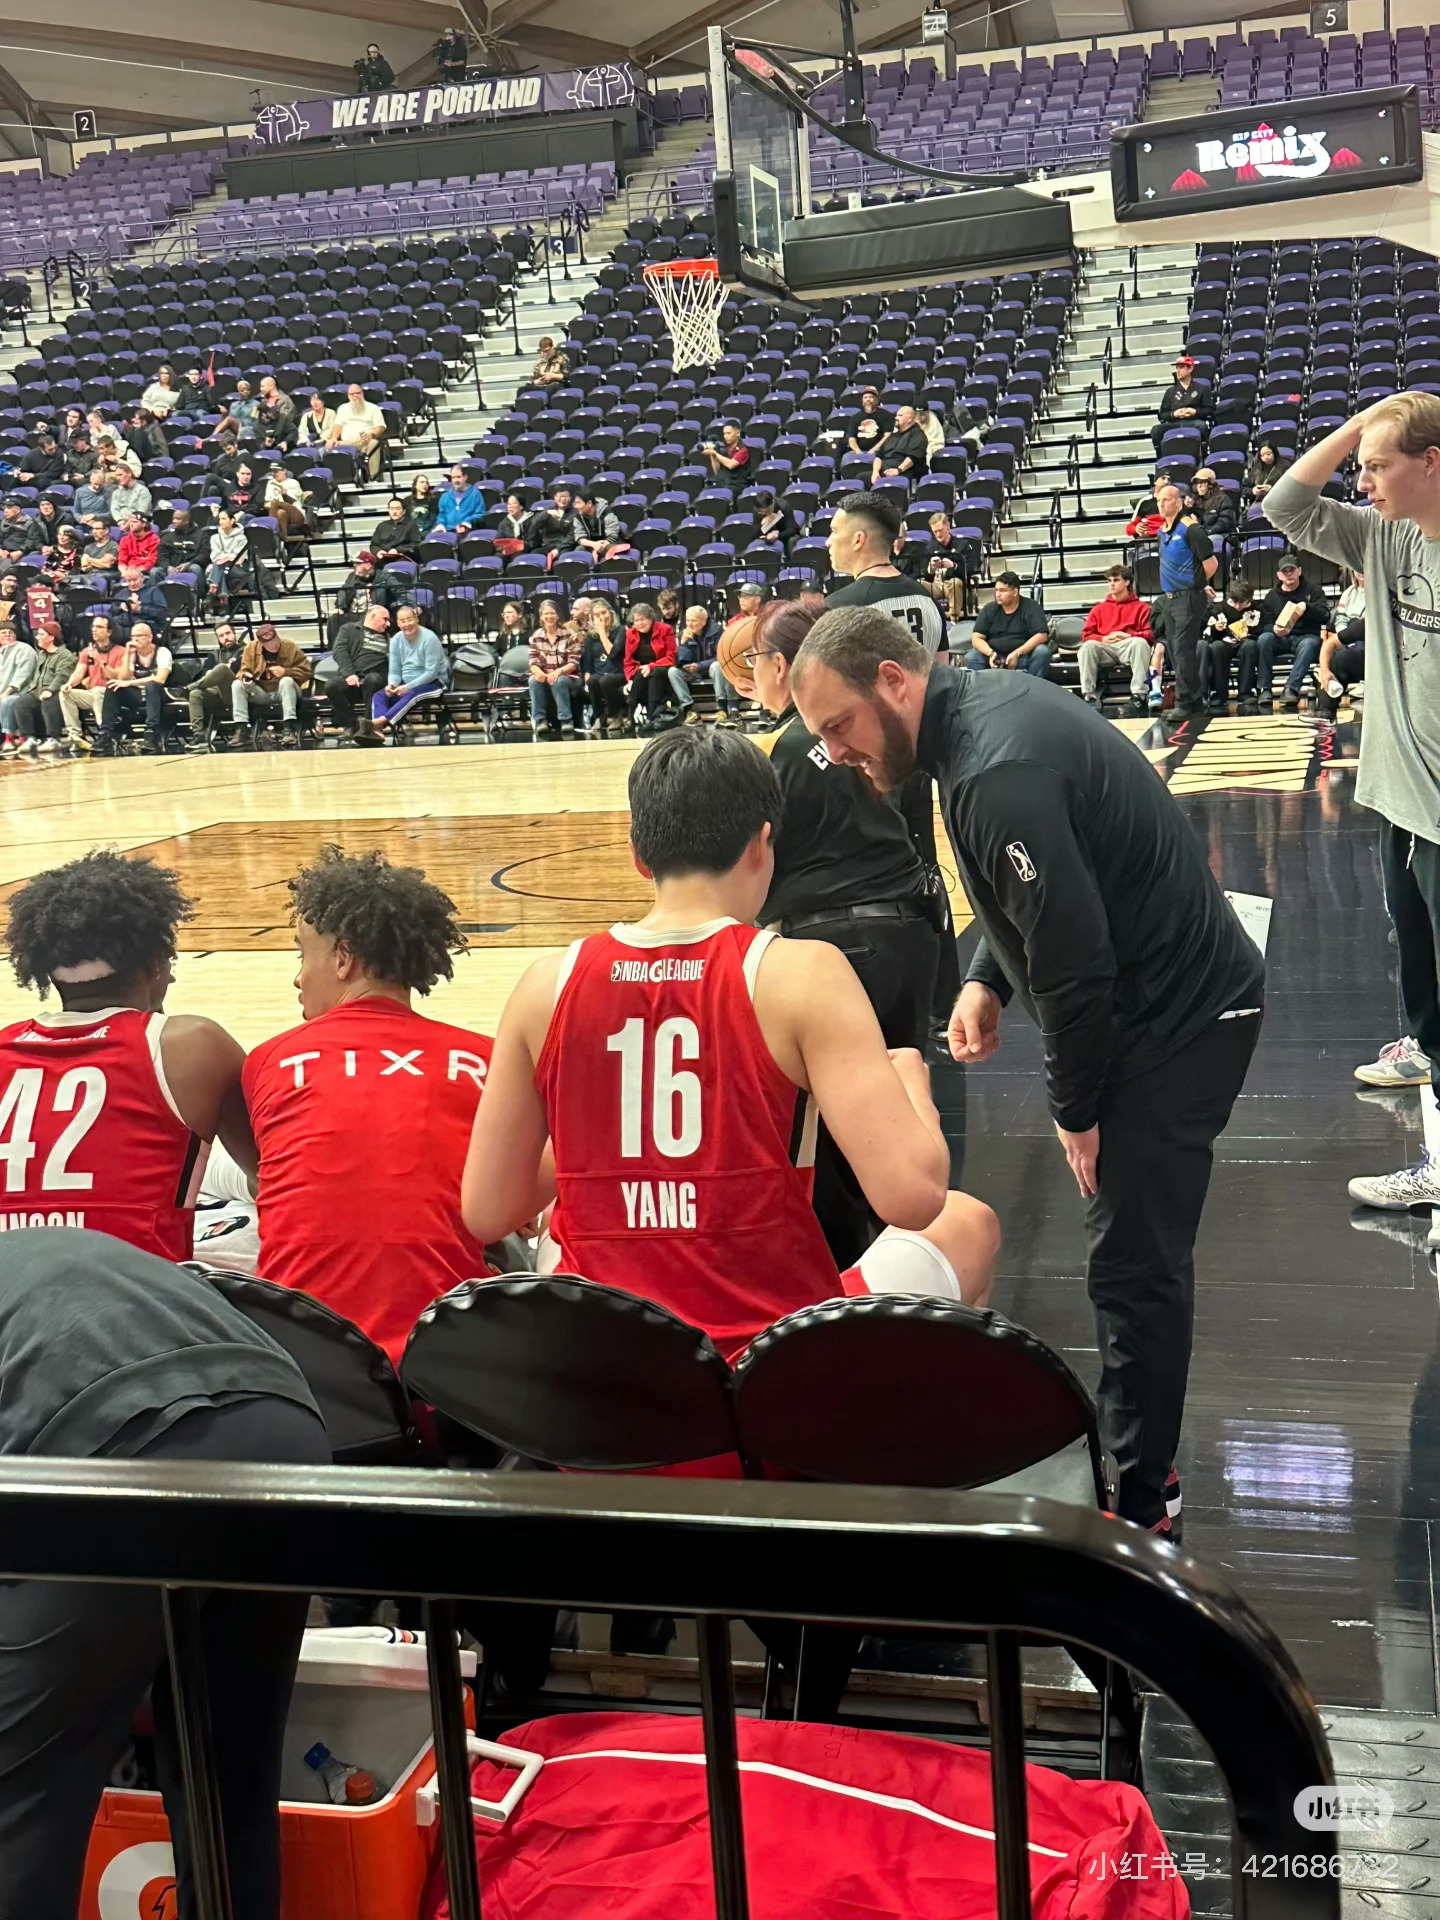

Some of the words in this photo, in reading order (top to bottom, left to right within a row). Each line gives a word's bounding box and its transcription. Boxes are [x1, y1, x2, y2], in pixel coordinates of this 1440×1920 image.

[1324, 8, 1337, 26] 5
[80, 116, 90, 131] 2
[332, 97, 370, 129] WE
[372, 91, 420, 124] ARE
[423, 77, 542, 124] PORTLAND
[1195, 125, 1331, 178] Remix
[553, 239, 564, 256] 3
[621, 960, 649, 983] NBA
[279, 1049, 488, 1091] TIXR
[606, 1016, 703, 1158] 16
[0, 1066, 107, 1192] 42
[620, 1180, 697, 1229] YANG
